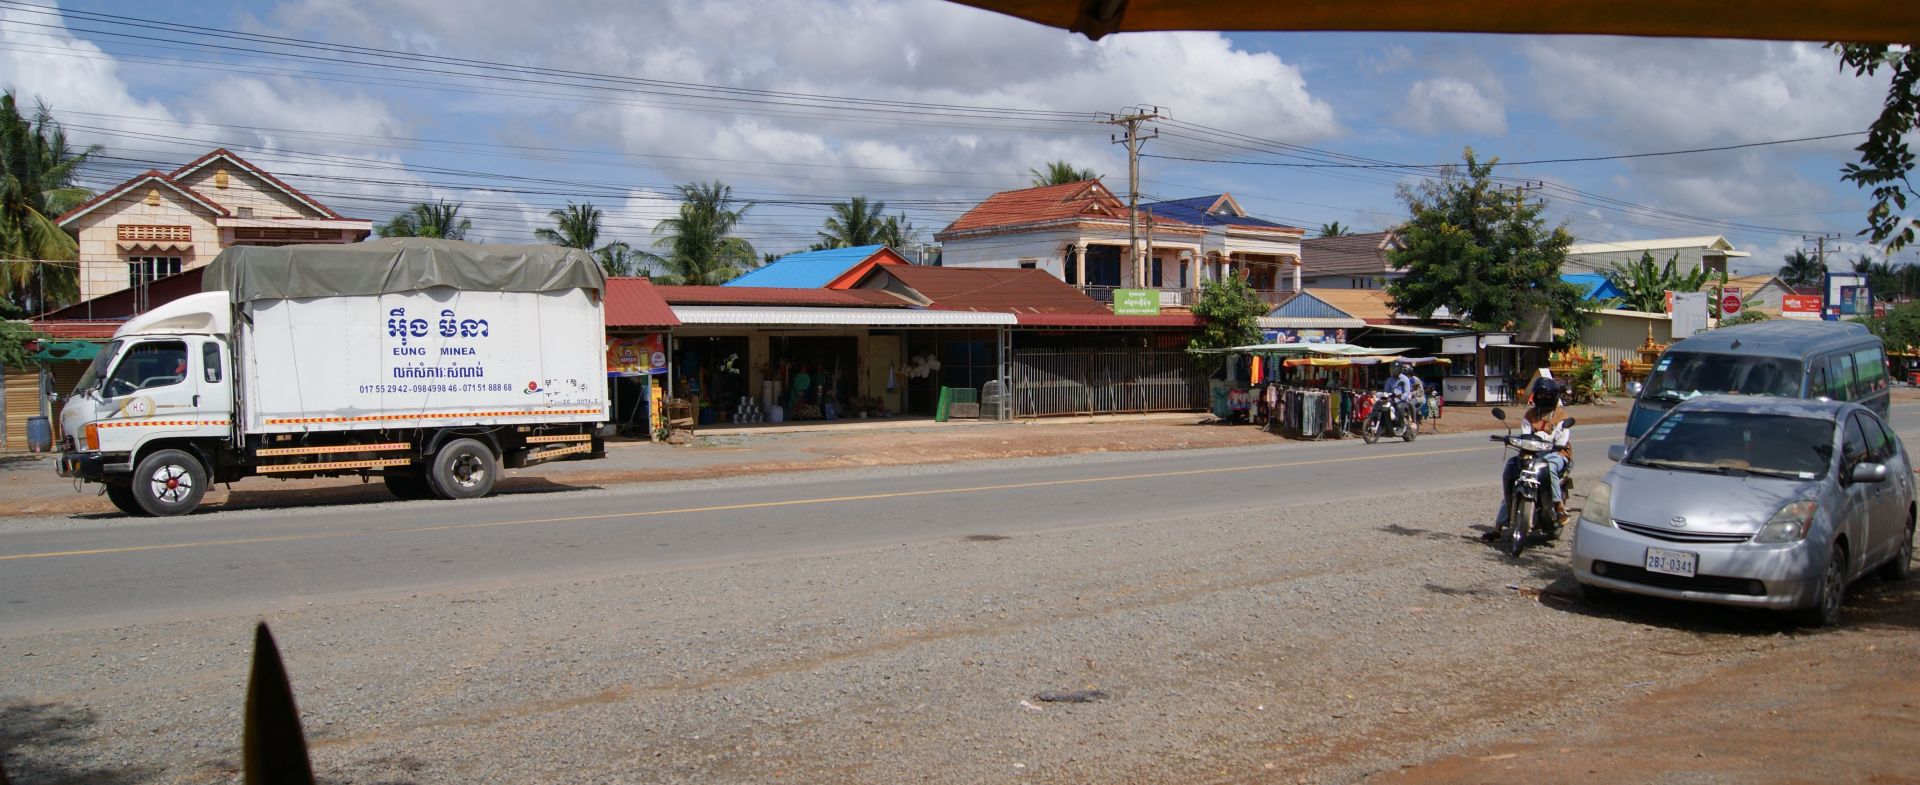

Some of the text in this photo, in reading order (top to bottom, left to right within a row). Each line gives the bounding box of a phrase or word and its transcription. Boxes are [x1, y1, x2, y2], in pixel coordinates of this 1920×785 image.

[393, 347, 476, 356] EUNG MINEA
[359, 385, 374, 394] 017
[375, 385, 385, 393] 55
